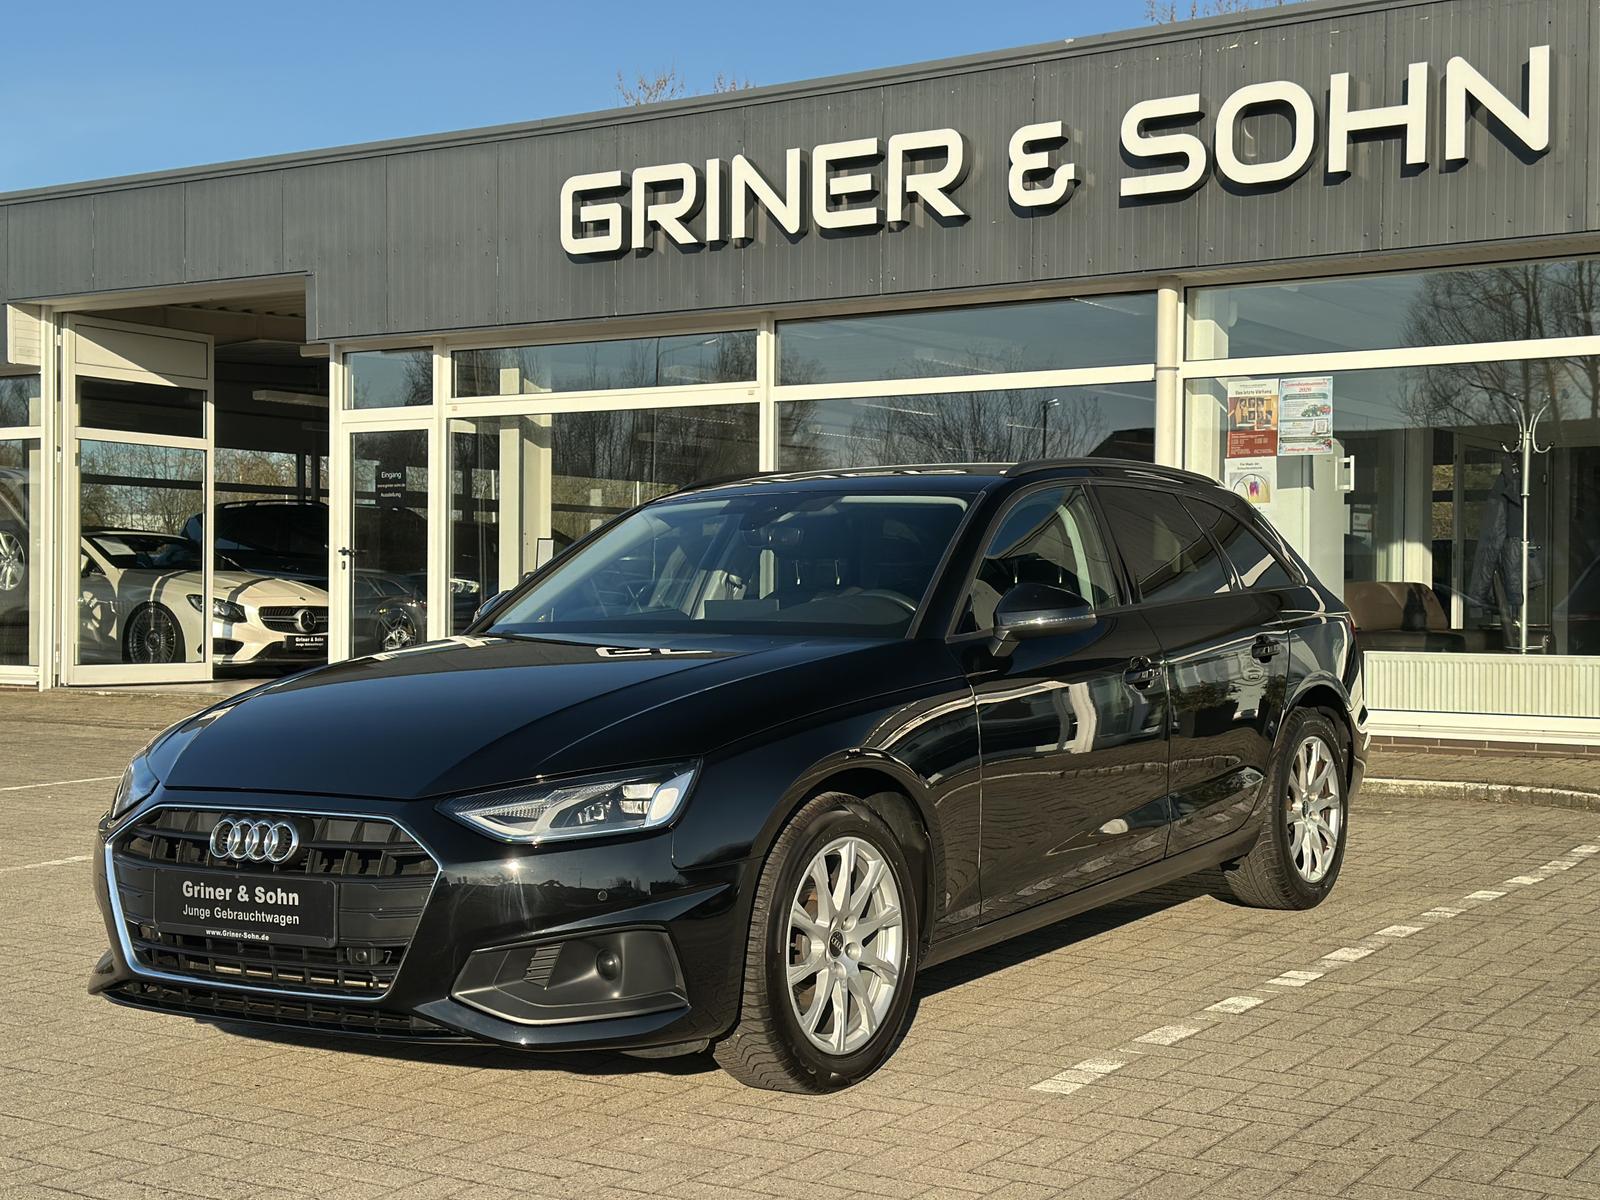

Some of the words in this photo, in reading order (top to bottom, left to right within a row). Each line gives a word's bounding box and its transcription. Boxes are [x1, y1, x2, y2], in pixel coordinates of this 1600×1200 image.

[560, 128, 966, 255] GRINER
[1008, 120, 1075, 207] &
[1120, 44, 1550, 197] SOHN
[382, 471, 402, 480] Eingang
[182, 880, 233, 901] Griner
[237, 884, 250, 903] &
[254, 887, 299, 906] Sohn
[182, 904, 211, 920] Junge
[213, 906, 300, 927] Gebrauchtwagen
[205, 928, 270, 942] www.Griner-Sohn.de
